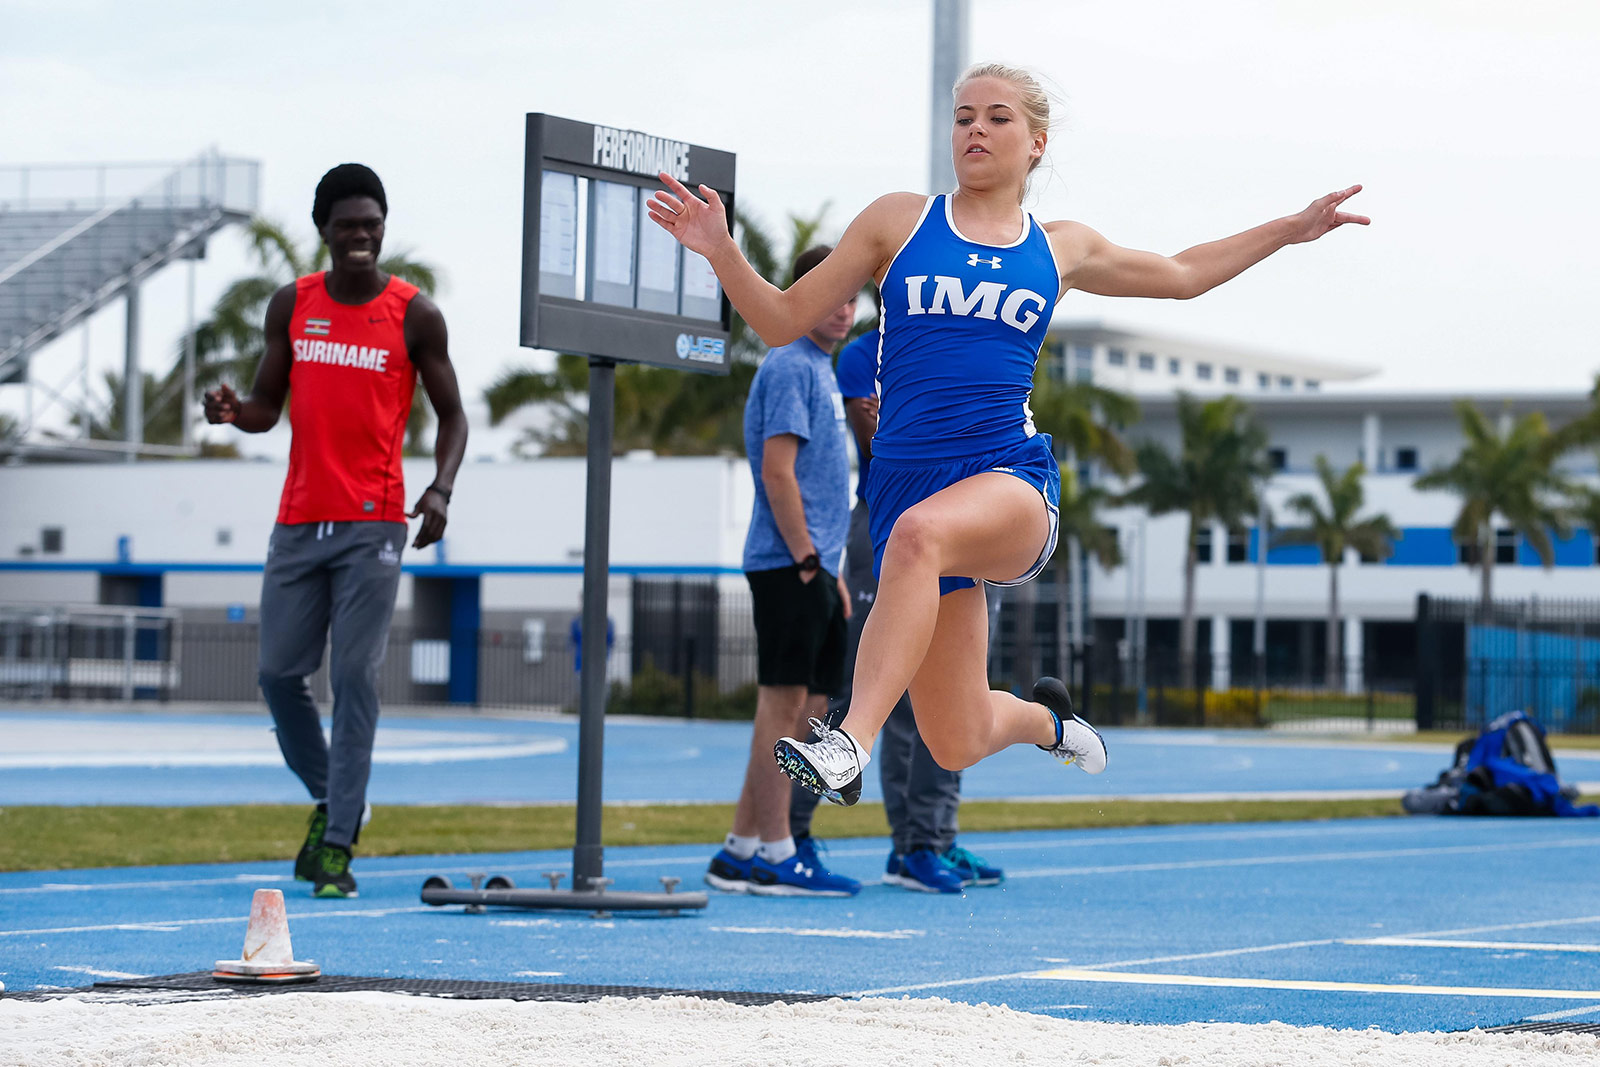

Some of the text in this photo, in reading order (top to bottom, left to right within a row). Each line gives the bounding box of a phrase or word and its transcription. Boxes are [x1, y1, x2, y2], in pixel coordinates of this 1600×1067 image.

[593, 125, 690, 182] PERFORMANCE
[905, 275, 1047, 333] IMG
[293, 338, 390, 373] SURINAME
